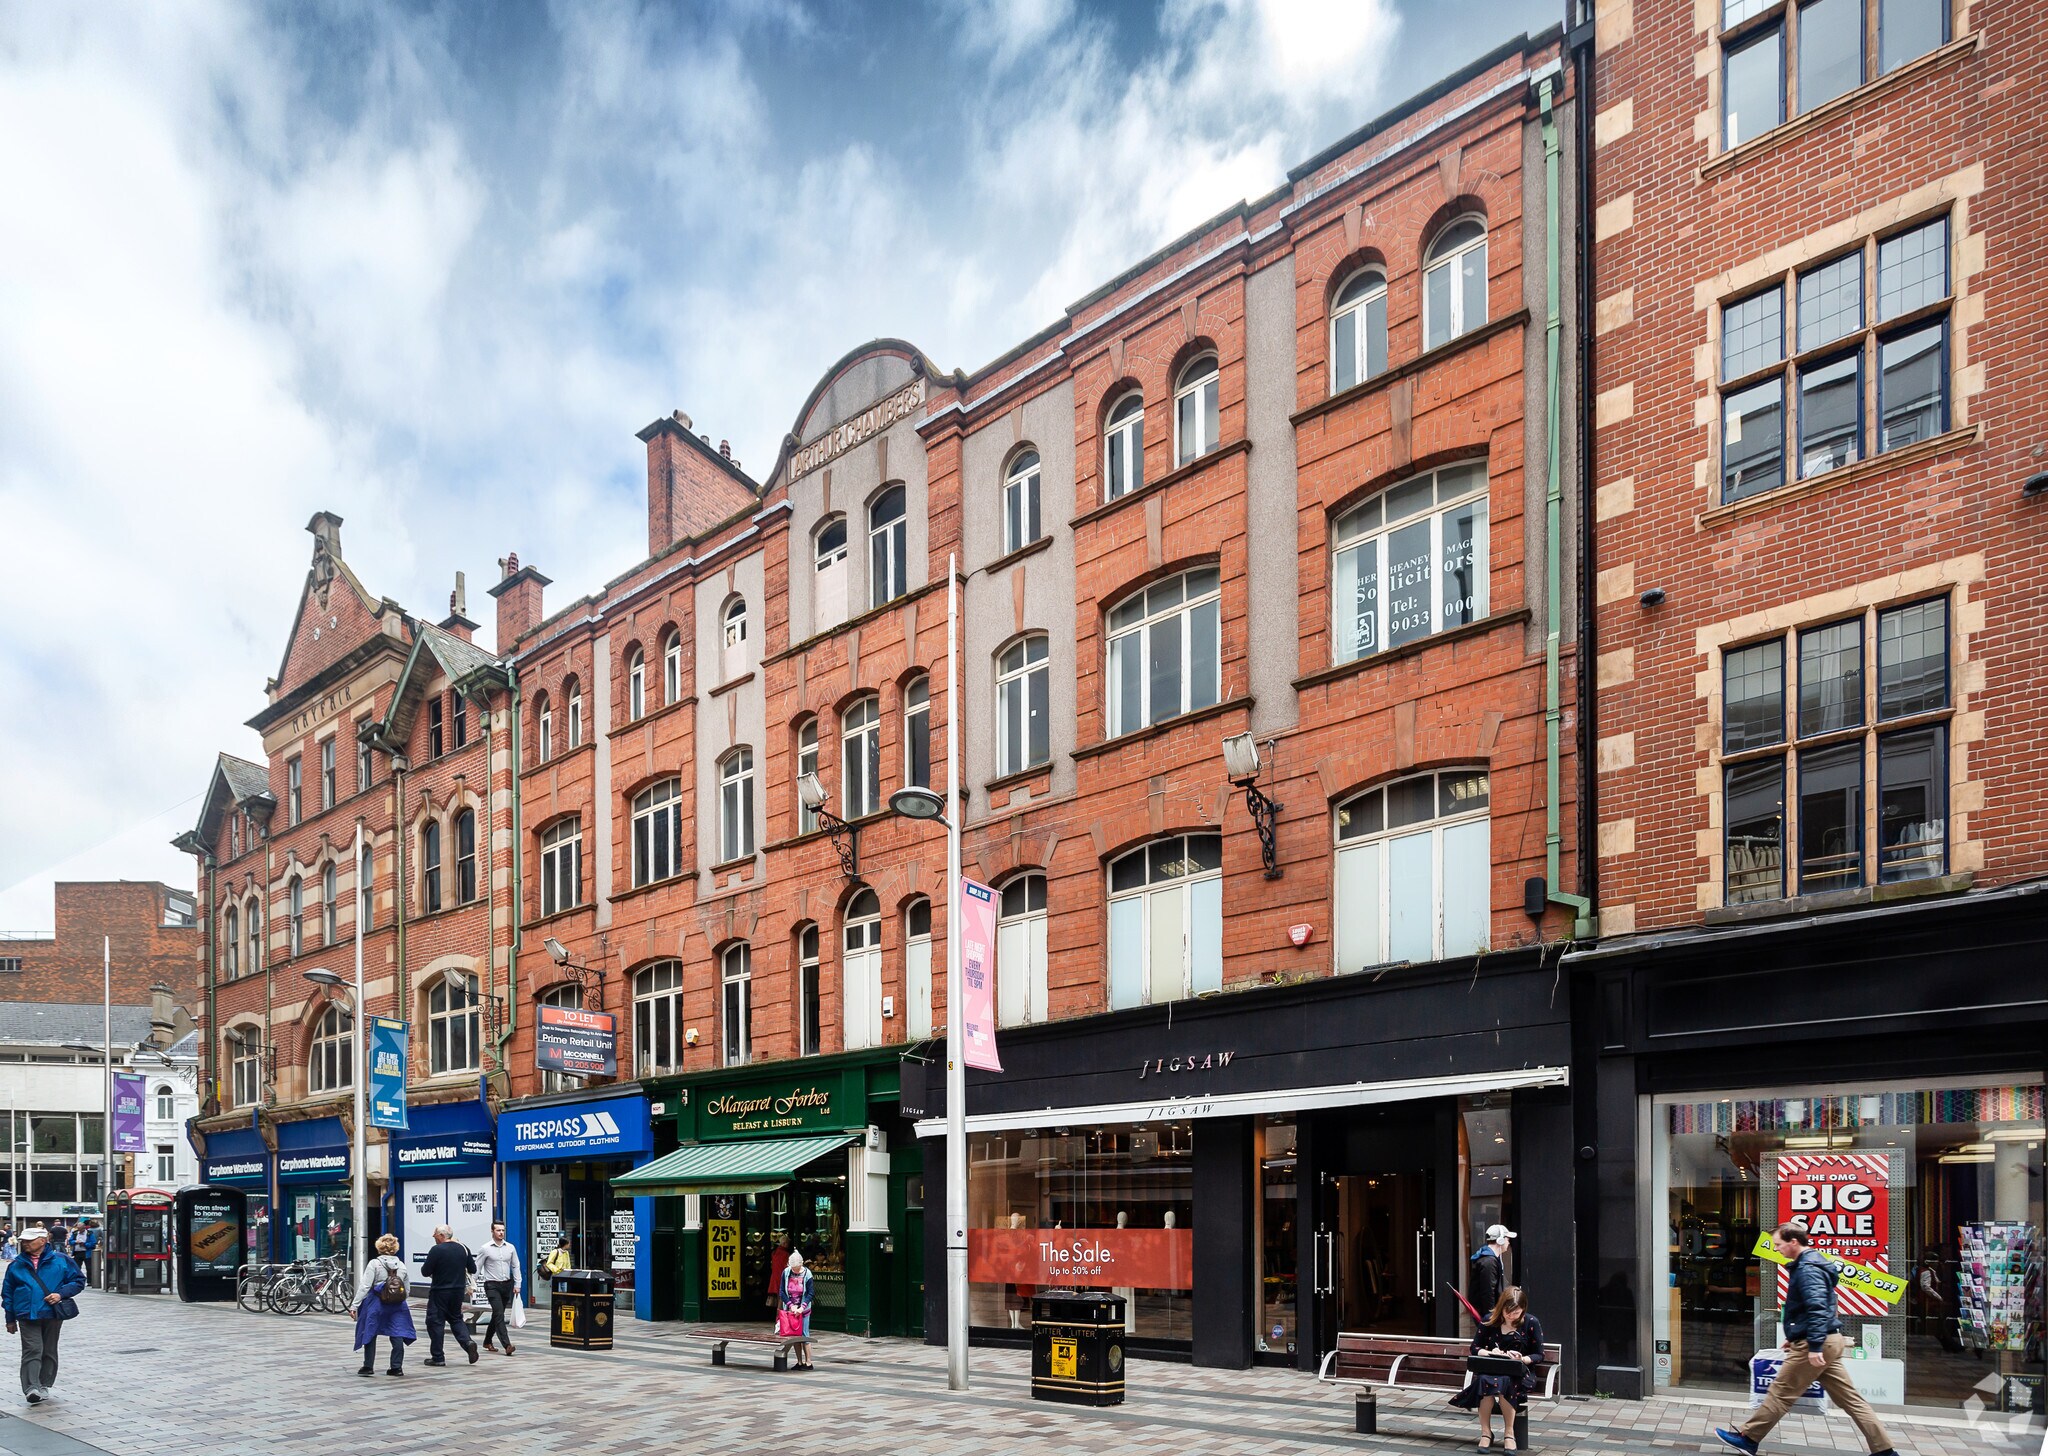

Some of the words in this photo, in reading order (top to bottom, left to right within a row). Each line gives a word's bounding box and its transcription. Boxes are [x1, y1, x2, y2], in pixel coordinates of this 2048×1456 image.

[794, 428, 844, 477] ARTHUR
[844, 381, 920, 446] CHAMBERS
[1390, 553, 1430, 575] HEANEY
[1391, 597, 1418, 615] Tel:
[1391, 610, 1430, 634] 9033
[292, 686, 352, 734] MAYFAIR
[969, 959, 981, 970] EVERY
[965, 967, 985, 981] THURSDAY
[563, 1011, 577, 1020] TO
[579, 1013, 595, 1023] LET
[542, 1034, 568, 1045] Prime
[569, 1037, 594, 1048] Retail
[596, 1040, 613, 1049] Unit
[575, 1061, 589, 1069] 205
[590, 1062, 605, 1071] 900
[1139, 1051, 1235, 1079] JIGSAW
[707, 1095, 772, 1119] Margaret
[774, 1087, 829, 1115] Forbes
[820, 1107, 830, 1115] Ltd
[902, 1106, 925, 1115] JIGSAW
[1147, 1104, 1214, 1119] JIGSAW
[515, 1117, 581, 1141] TRESPASS
[732, 1121, 762, 1131] BELFAST
[763, 1120, 769, 1128] &
[771, 1117, 803, 1127] LISBURN
[462, 1147, 493, 1155] Warehouse
[464, 1141, 491, 1149] Carphone
[515, 1142, 555, 1152] PERFORMANCE
[557, 1139, 586, 1148] OUTDOOR
[589, 1136, 620, 1146] CLOTHING
[398, 1147, 437, 1163] Carphone
[209, 1164, 233, 1177] Carphone
[232, 1162, 263, 1174] Warehouse
[280, 1158, 310, 1172] Carphone
[309, 1155, 345, 1169] Warehouse
[1805, 1174, 1827, 1182] THE
[1829, 1173, 1857, 1181] OMG
[411, 1195, 418, 1203] WE
[457, 1193, 464, 1202] WE
[1790, 1183, 1874, 1212] BIG
[416, 1205, 425, 1213] YOU
[425, 1204, 435, 1213] SAVE
[462, 1203, 471, 1213] YOU
[471, 1203, 482, 1212] SAVE
[1790, 1214, 1874, 1236] SALE
[712, 1225, 737, 1243] 25%
[1761, 1240, 1770, 1249] A
[1836, 1239, 1878, 1247] THINGS
[713, 1245, 736, 1262] OFF
[1040, 1242, 1069, 1262] The
[1072, 1240, 1115, 1263] Sale.
[1844, 1248, 1860, 1256] £5
[718, 1266, 731, 1278] All
[1049, 1267, 1060, 1276] Up
[1062, 1267, 1070, 1275] to
[1072, 1266, 1089, 1275] 50%
[1090, 1266, 1101, 1275] off
[711, 1279, 738, 1291] Stock
[1839, 1278, 1859, 1288] ODAY!
[1874, 1279, 1898, 1293] OFF
[1037, 1327, 1062, 1335] LITTER
[1070, 1329, 1095, 1337] LITTER
